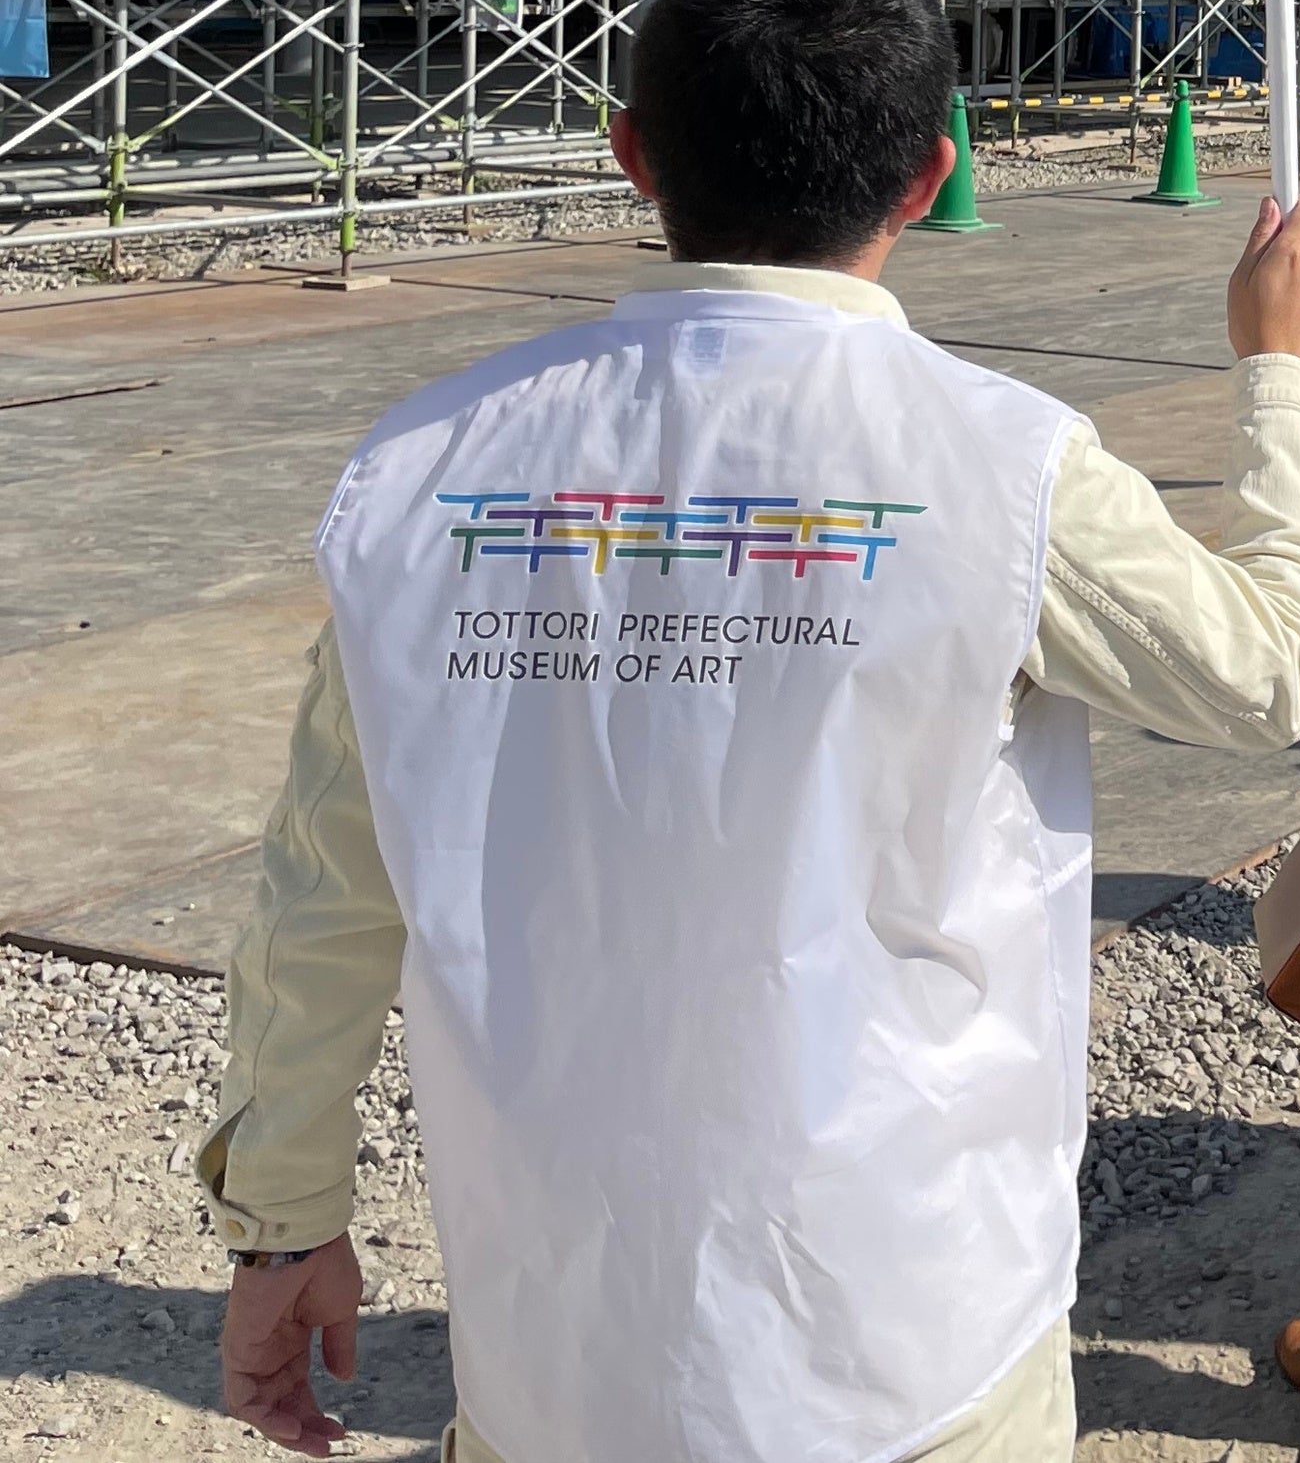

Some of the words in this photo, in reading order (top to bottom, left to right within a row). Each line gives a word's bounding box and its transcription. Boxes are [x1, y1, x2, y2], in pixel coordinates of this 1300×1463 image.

[454, 610, 600, 641] TOTTORI
[618, 614, 861, 647] PREFECTURAL
[447, 651, 600, 682] MUSEUM
[615, 654, 661, 684] OF
[672, 654, 744, 685] ART
